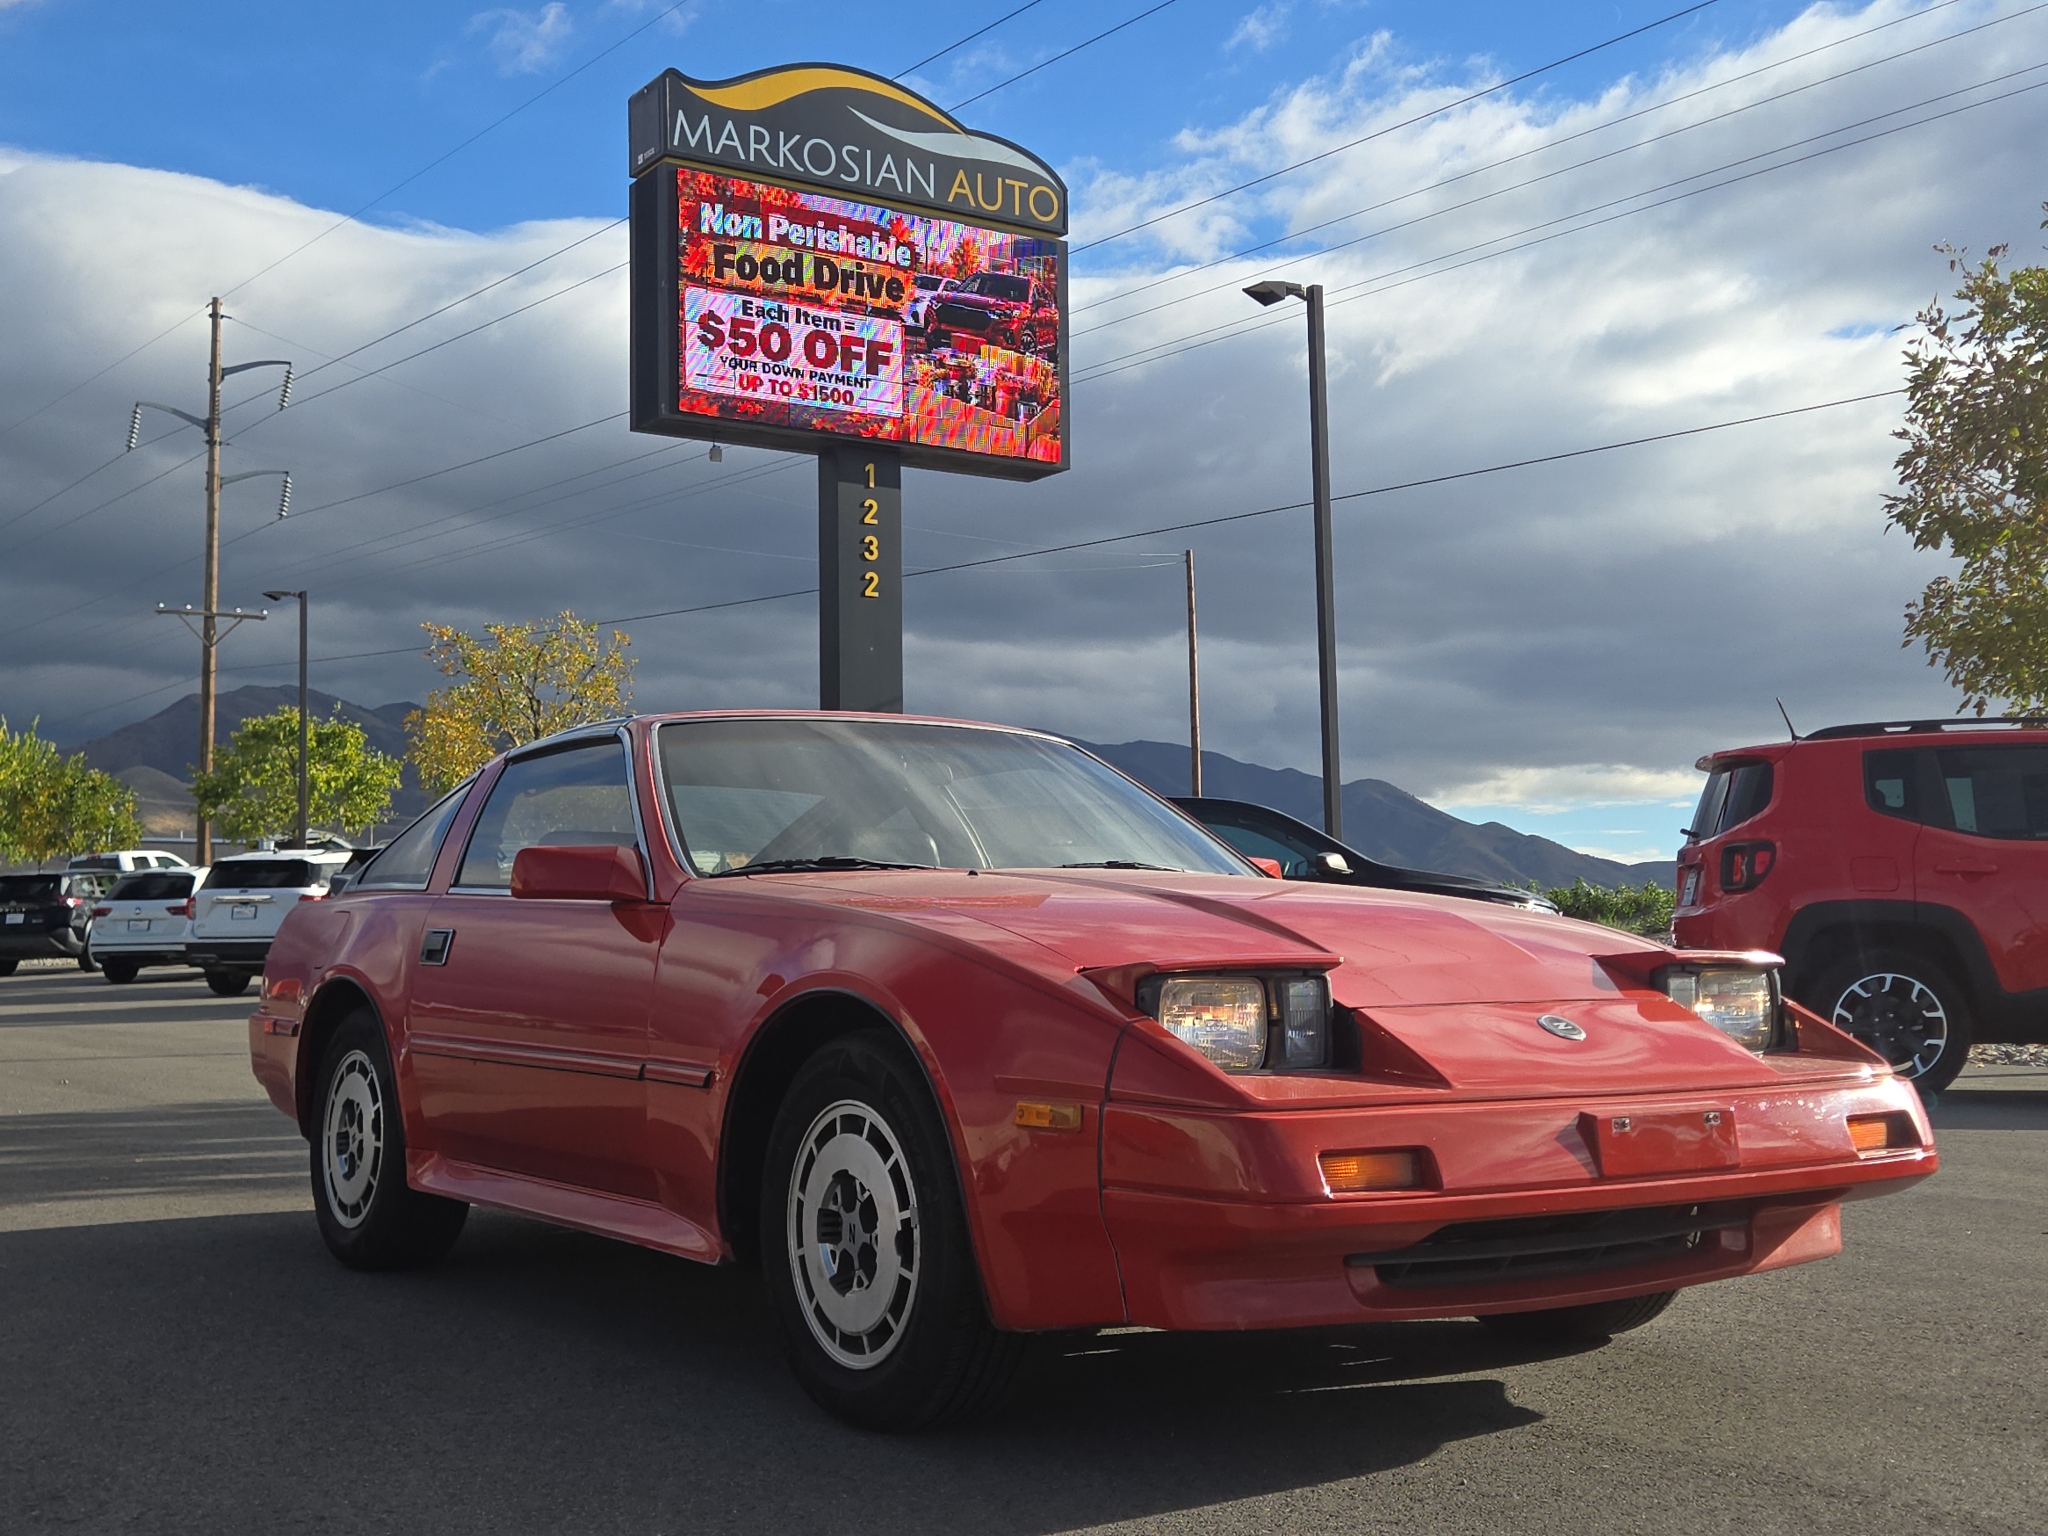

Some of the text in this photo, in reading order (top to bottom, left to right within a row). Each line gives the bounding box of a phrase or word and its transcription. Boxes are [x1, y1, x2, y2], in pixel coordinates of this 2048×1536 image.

[673, 109, 1059, 222] MARKOSIAN AUTO
[700, 202, 912, 268] Non Perishable
[713, 244, 905, 302] Food Drive
[697, 310, 893, 376] $50 OFF
[741, 301, 790, 324] Each
[795, 308, 841, 331] Item
[720, 356, 872, 389] YOUR DOWN PAYMENT
[738, 374, 855, 405] UP TO $1500
[864, 463, 879, 598] 1232
